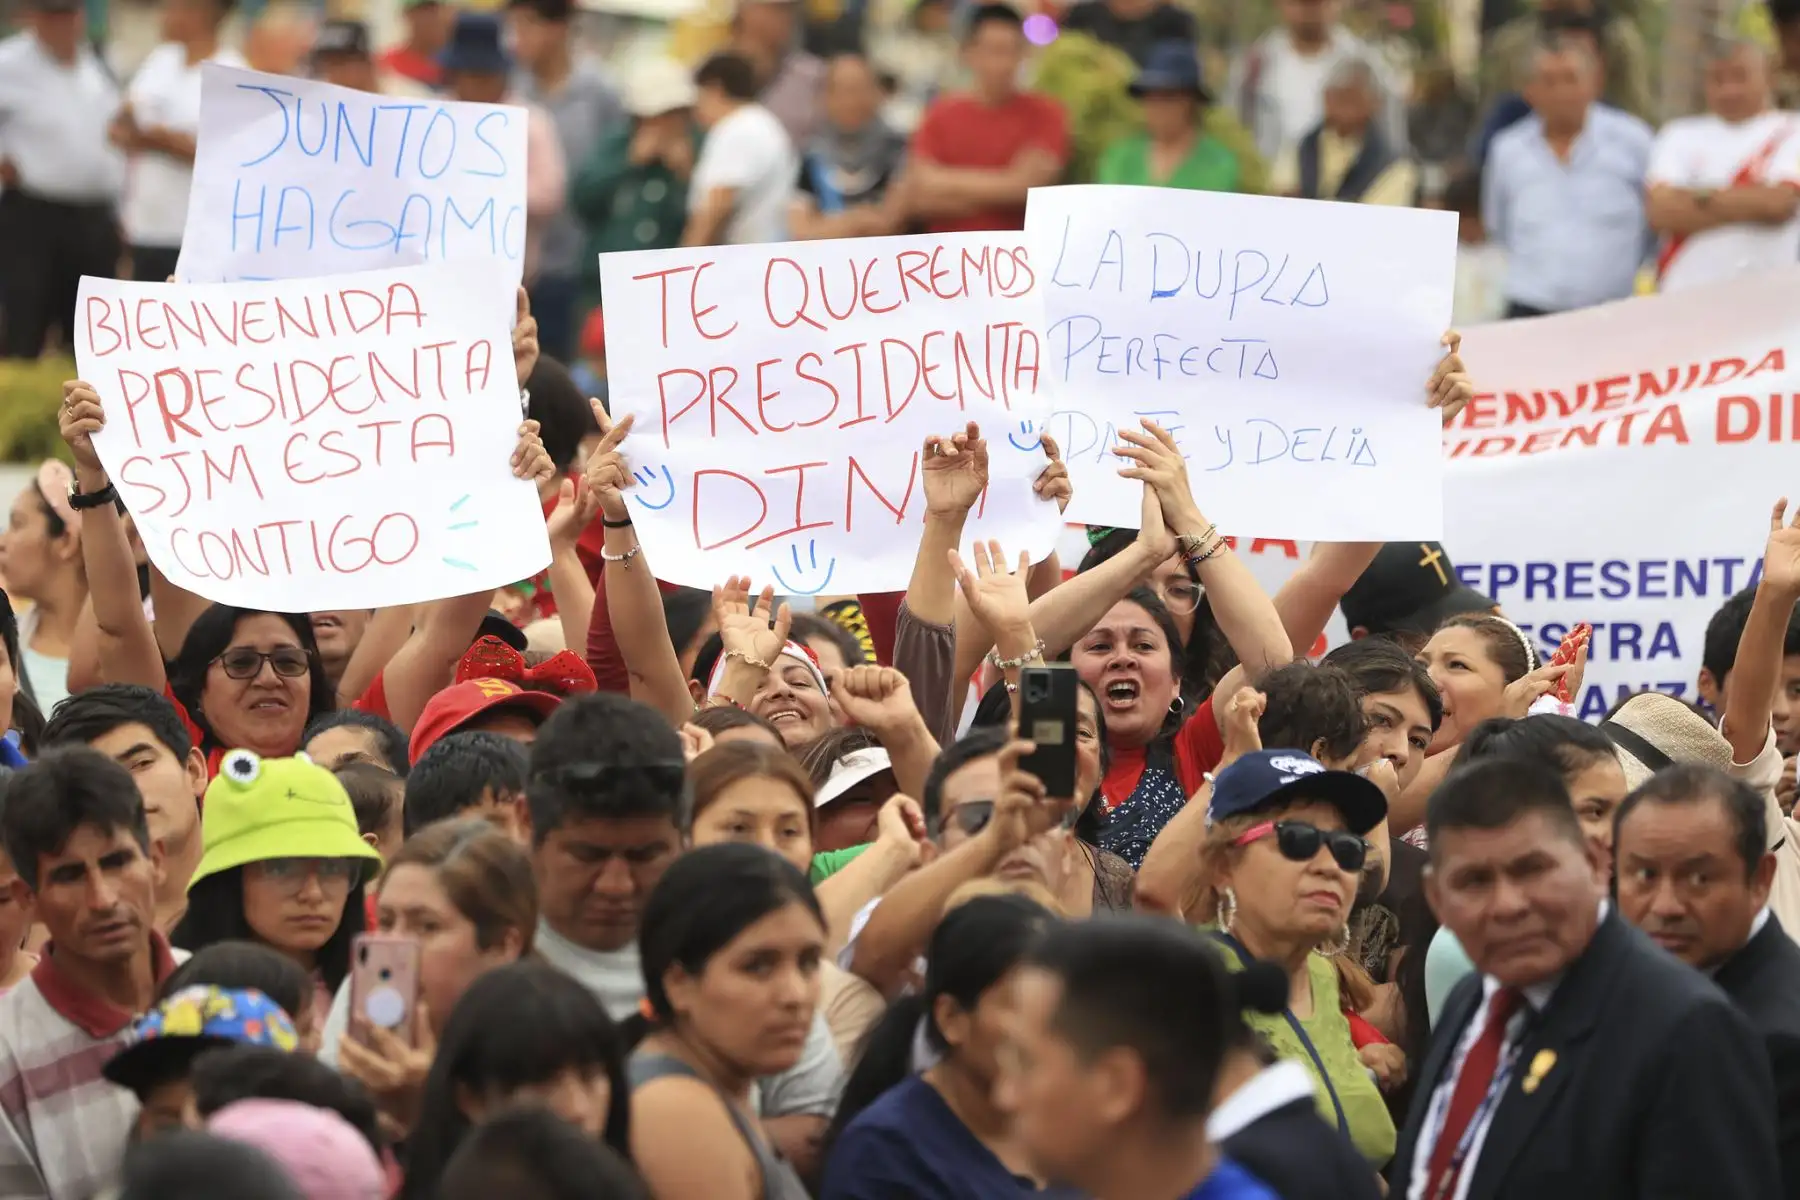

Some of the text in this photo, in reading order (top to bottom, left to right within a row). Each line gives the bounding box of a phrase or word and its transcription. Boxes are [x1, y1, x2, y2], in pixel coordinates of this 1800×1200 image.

[235, 83, 510, 179] JUNTOS
[632, 245, 1035, 349] TE QUEREMOS
[1051, 215, 1329, 321] LA DUPLA
[86, 282, 428, 357] BIENVENIDA
[1046, 315, 1279, 382] PERFECTA
[117, 339, 492, 448] PRESIDENTA
[657, 320, 1040, 449] PRESIDENTA
[1443, 403, 1691, 459] IDENTA
[120, 413, 456, 518] SJM ESTA
[692, 451, 988, 551] DIN
[170, 511, 420, 581] CONTIGO
